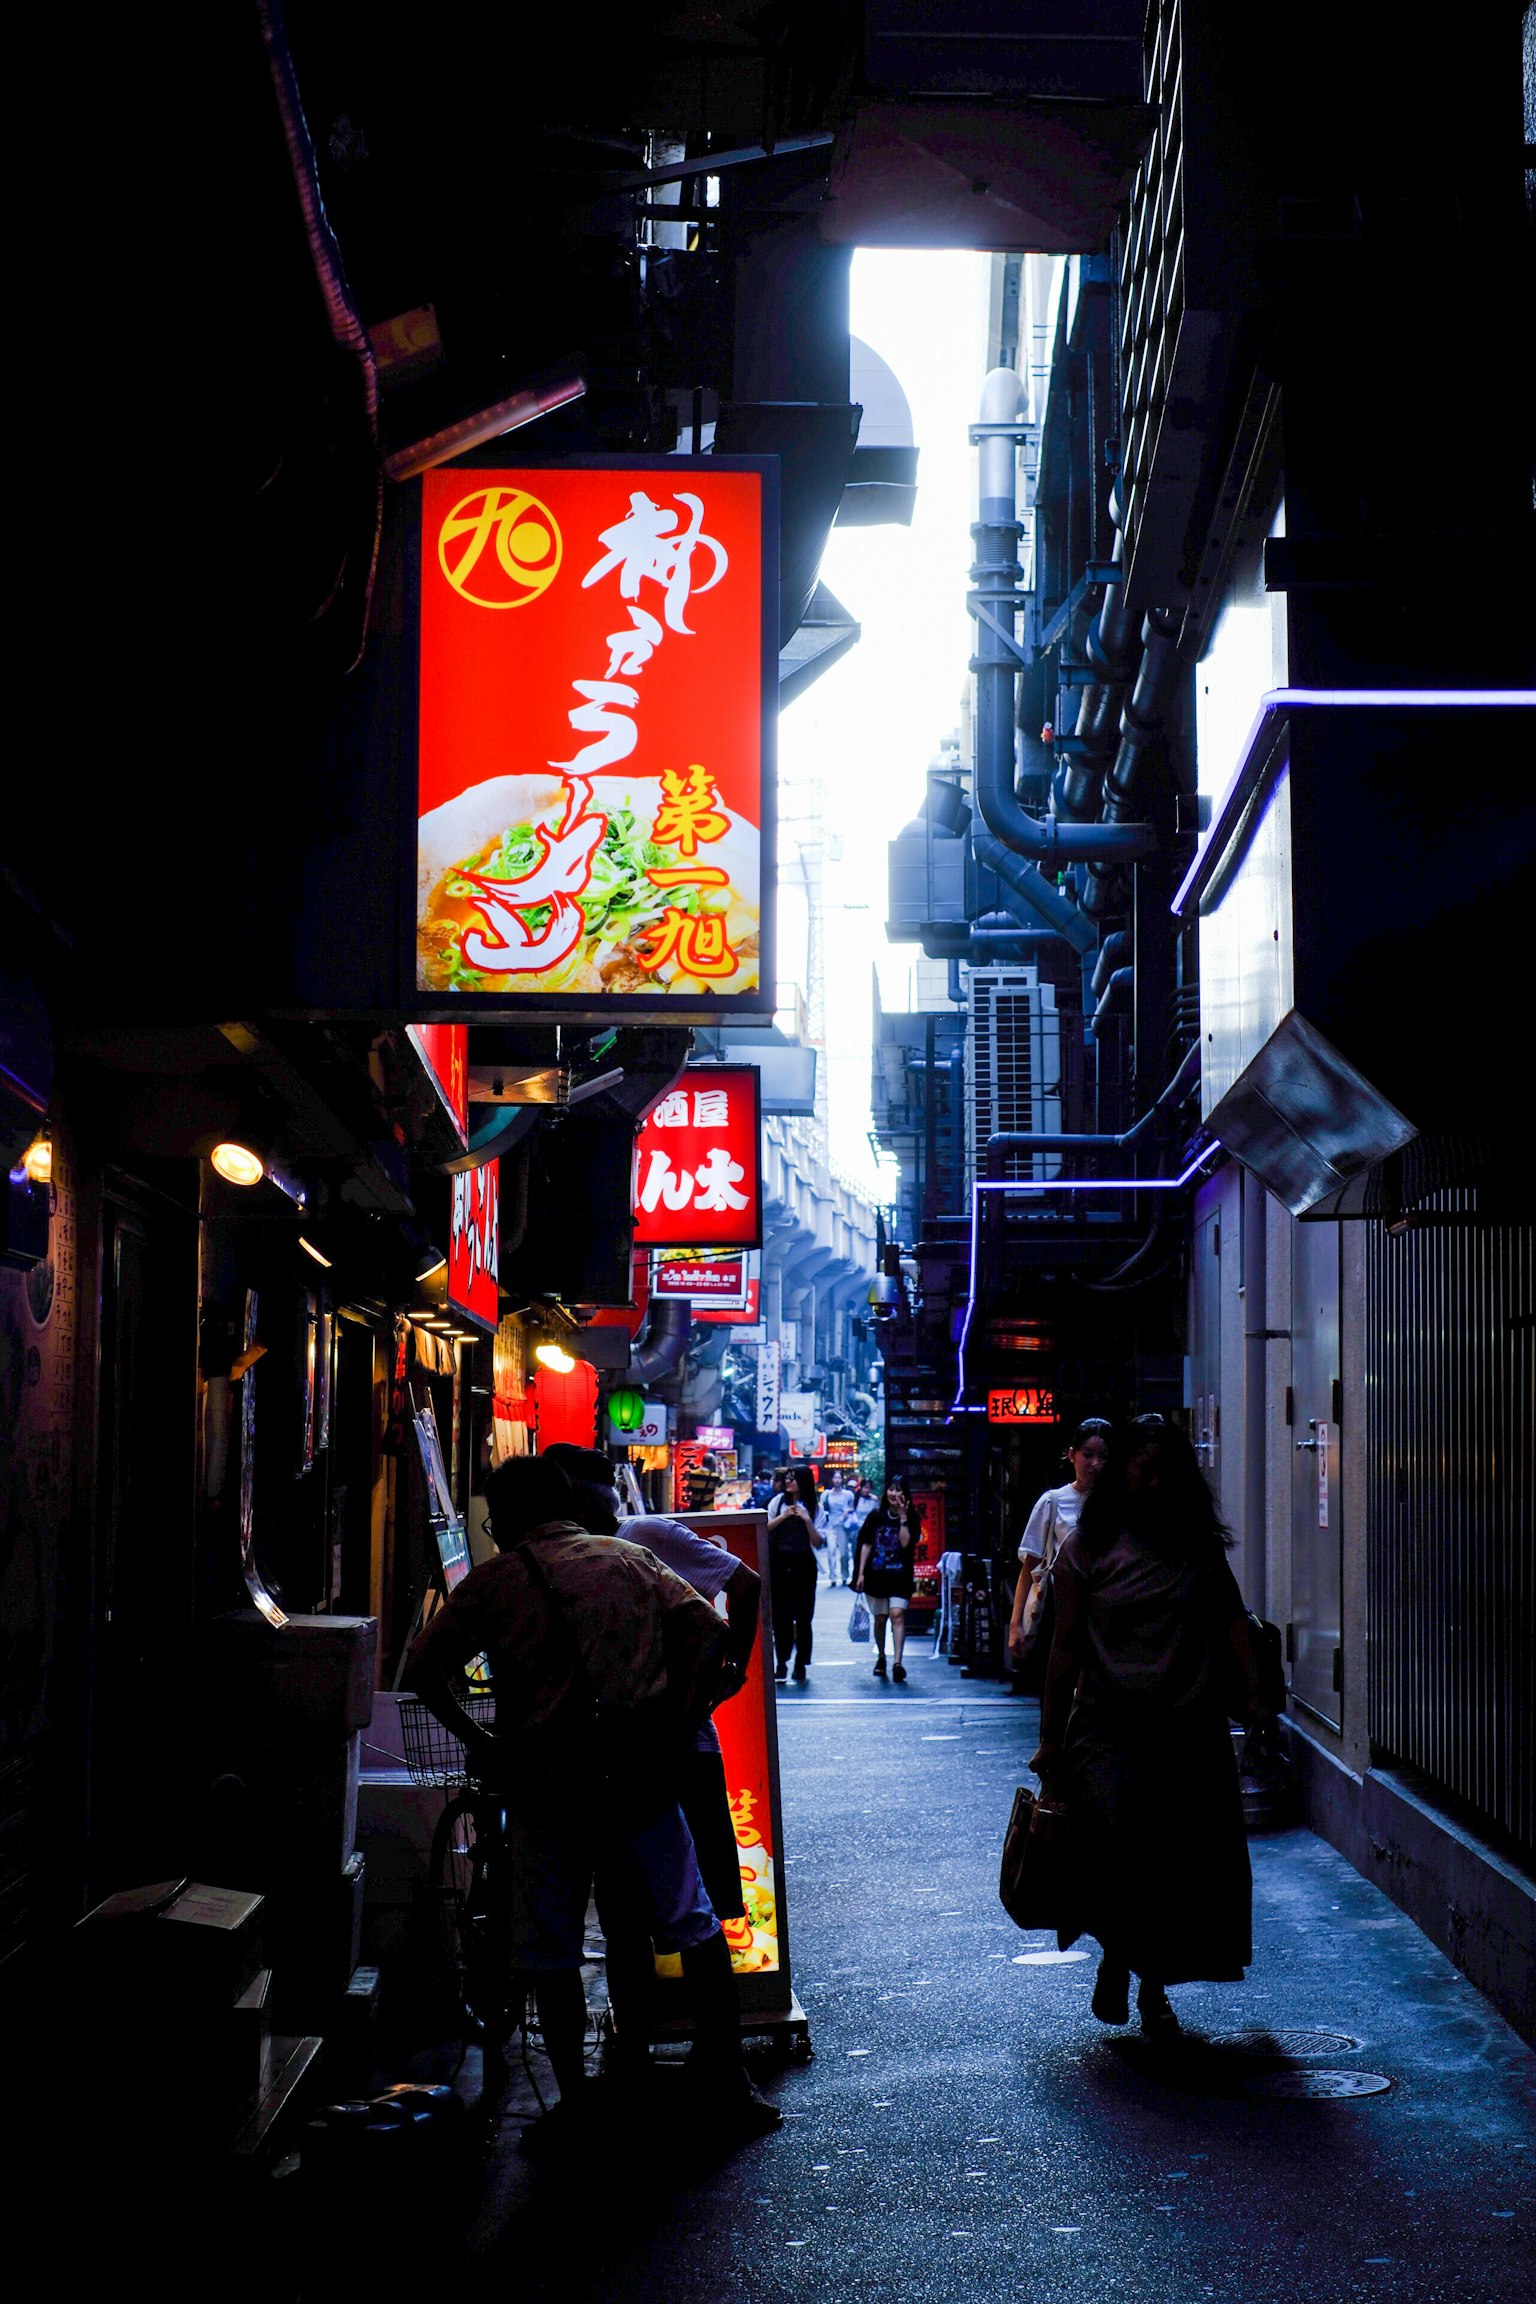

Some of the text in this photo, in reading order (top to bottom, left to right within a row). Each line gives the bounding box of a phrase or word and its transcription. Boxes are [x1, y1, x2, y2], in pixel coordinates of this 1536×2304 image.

[636, 764, 739, 979] 第一旭
[641, 1089, 729, 1128] 酒屋
[635, 1147, 750, 1213] ん太
